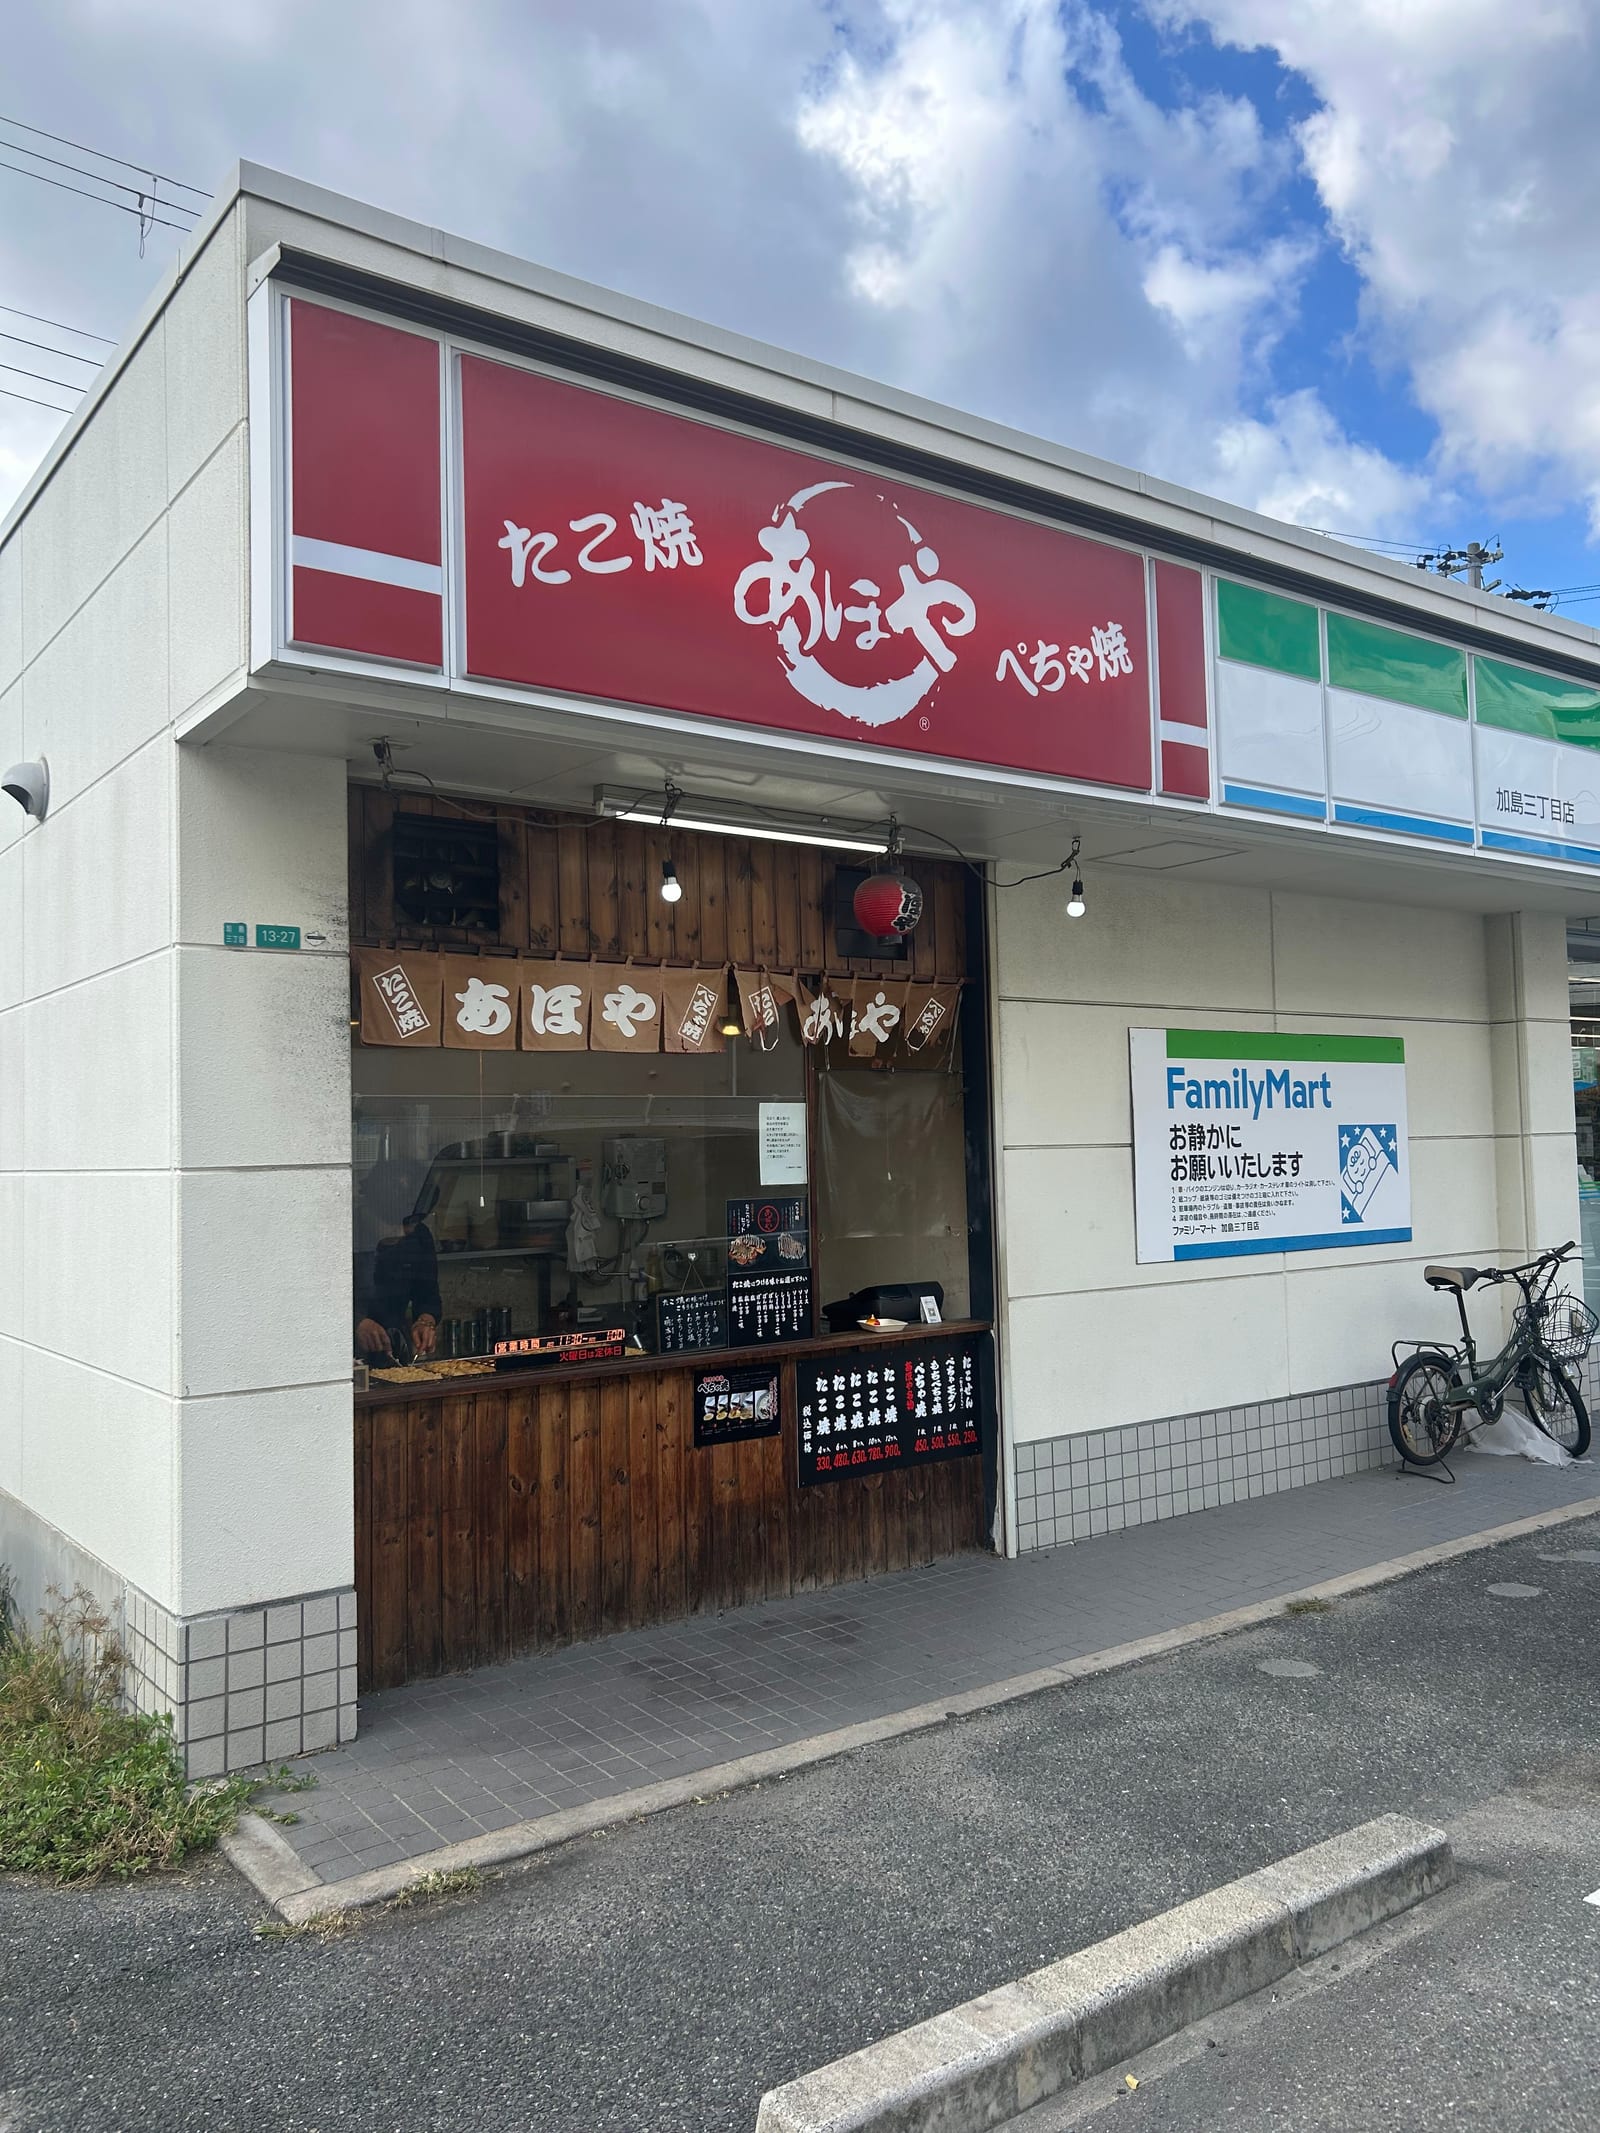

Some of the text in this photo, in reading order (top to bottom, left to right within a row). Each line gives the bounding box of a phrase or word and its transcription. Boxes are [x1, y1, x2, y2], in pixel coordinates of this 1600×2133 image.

[499, 497, 703, 587] たこ焼
[734, 512, 976, 672] あほや
[996, 621, 1134, 696] ぺちゃ焼
[1496, 787, 1574, 824] 加島三丁目店
[262, 930, 296, 943] 13-27
[382, 973, 425, 1033] たこ焼
[455, 977, 656, 1038] あほや
[682, 990, 715, 1040] ぺちゃ焼
[1167, 1067, 1332, 1120] FamilyMart
[1169, 1123, 1242, 1151] お静かに
[1170, 1151, 1303, 1181] お願いいたします
[1172, 1221, 1260, 1236] ファミリーマート 加島三丁目店
[560, 1346, 622, 1361] 火曜日は定休日
[816, 1377, 831, 1436] たこ焼
[832, 1374, 847, 1432] たこ焼
[850, 1372, 865, 1429] たこ焼
[866, 1370, 881, 1427] たこ焼
[883, 1367, 898, 1424] たこ焼
[914, 1362, 927, 1418] ぺちゃ焼
[945, 1357, 957, 1412] ぺちゃモダン
